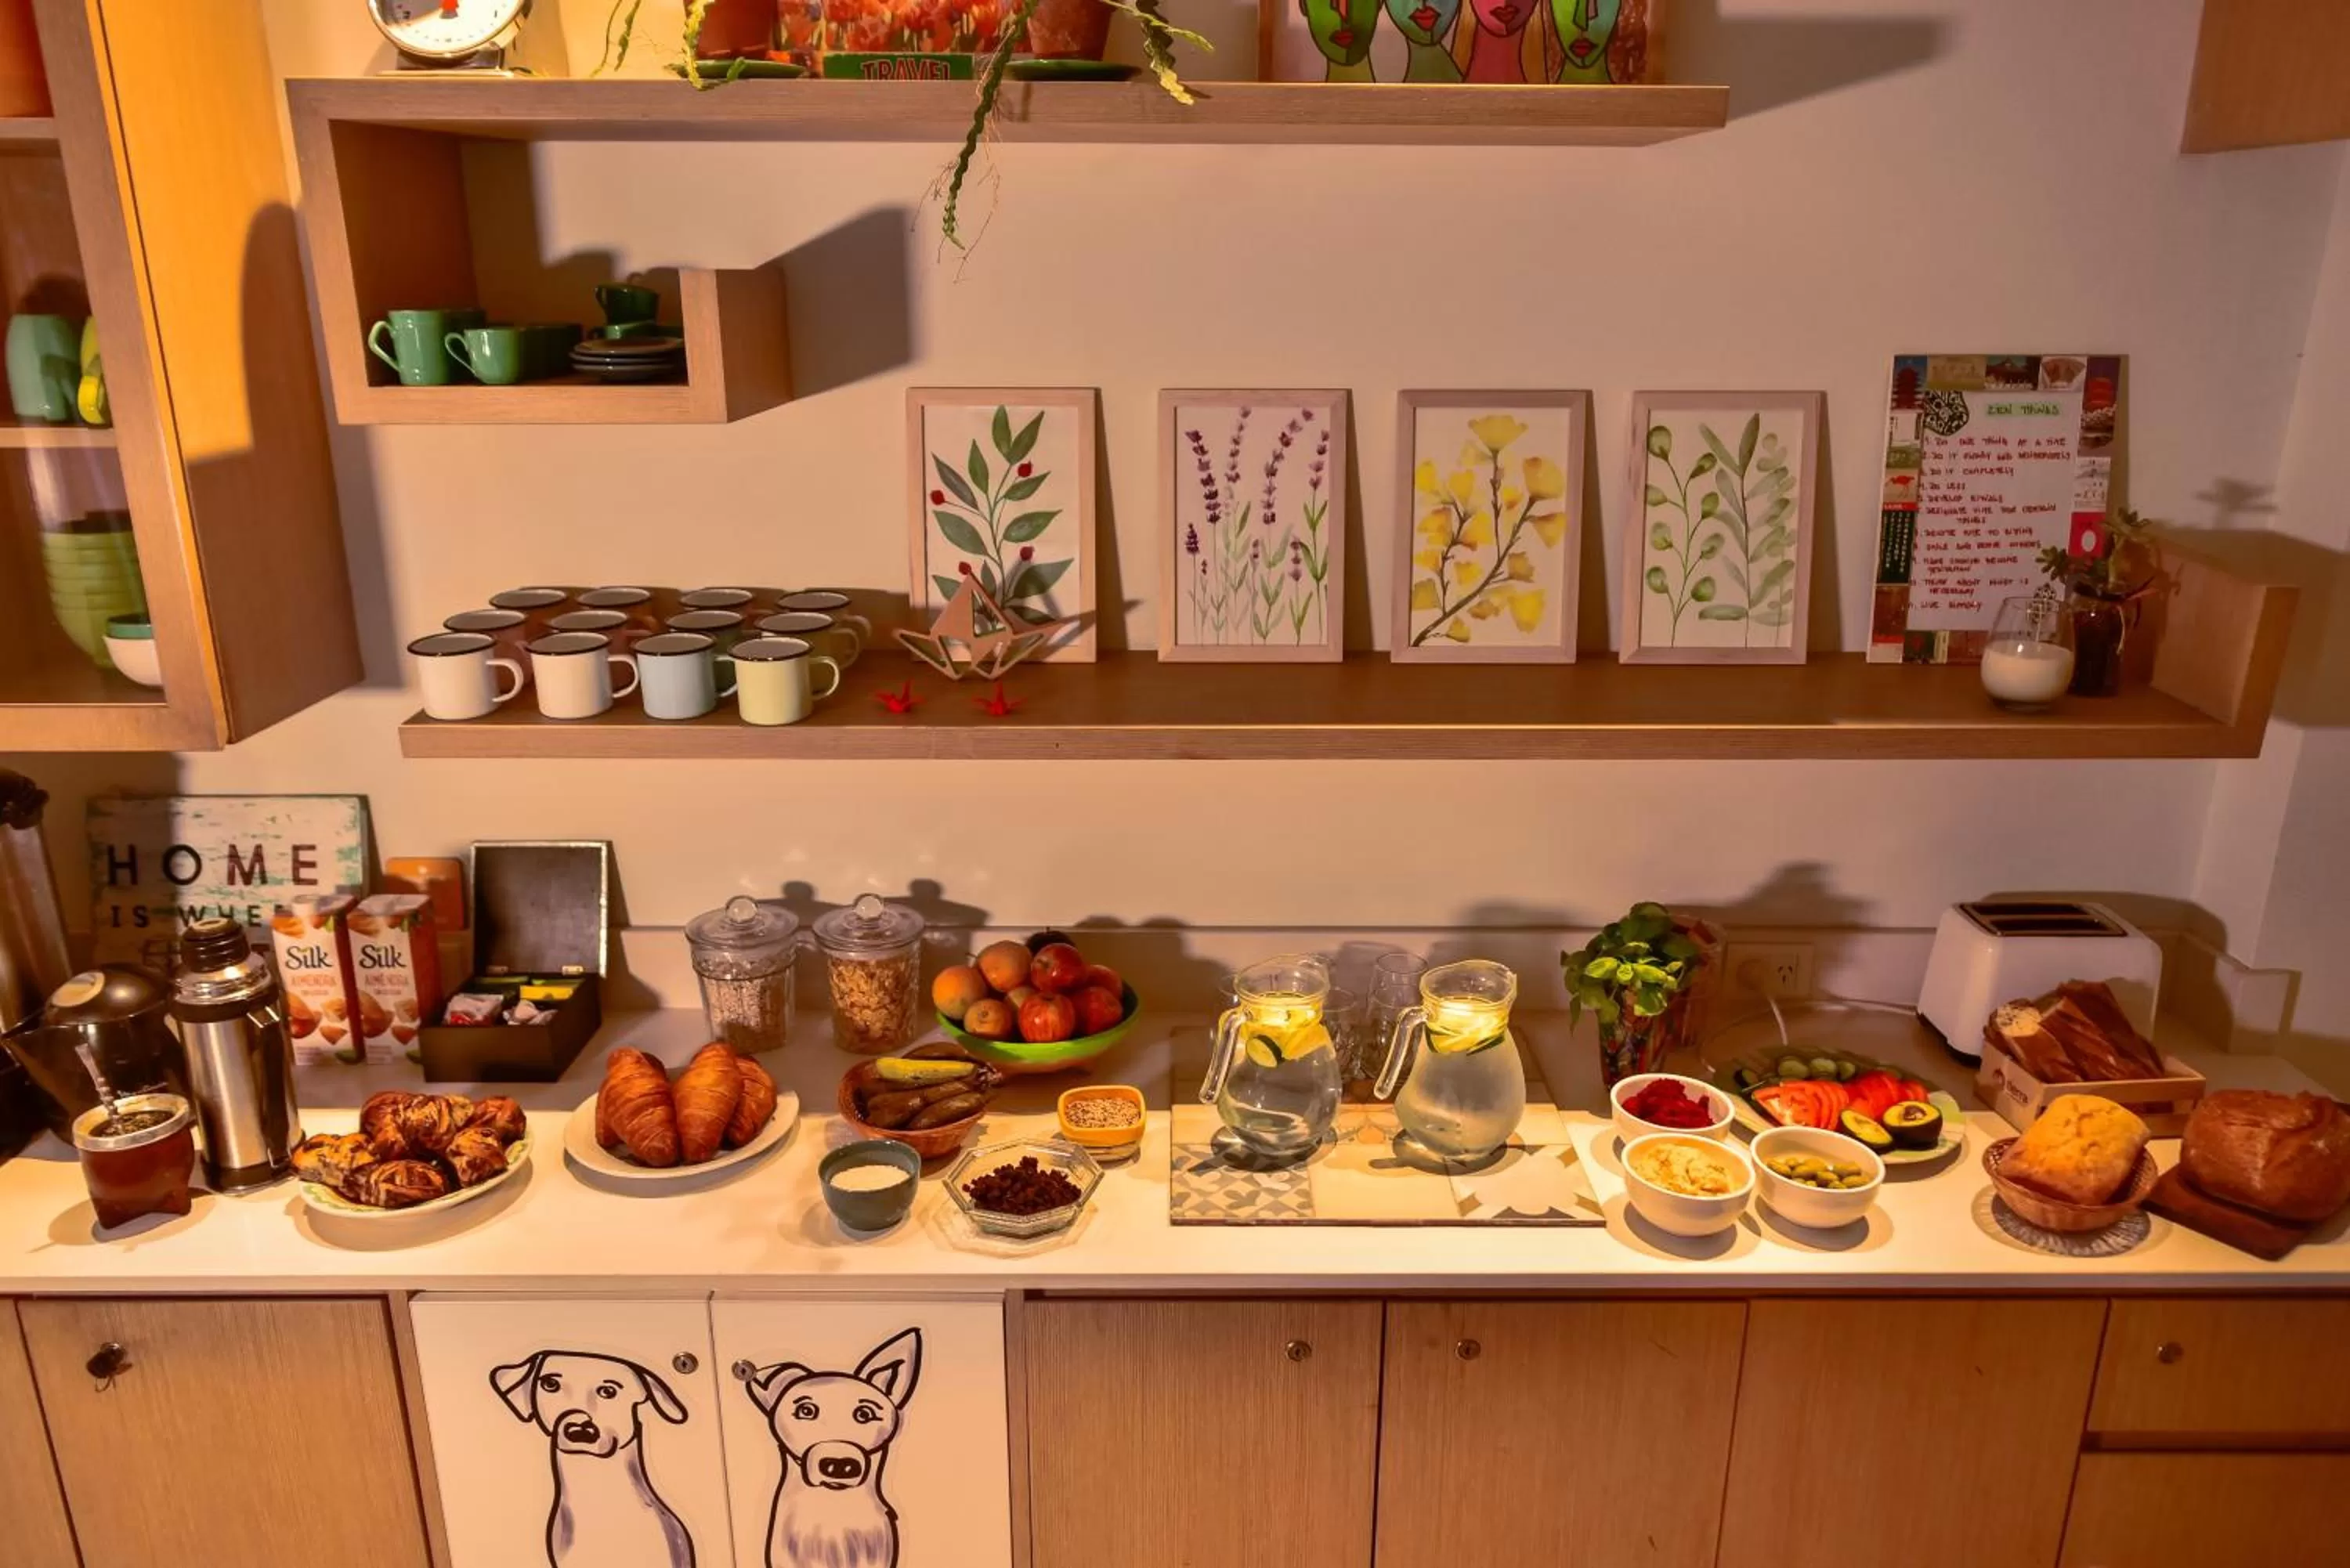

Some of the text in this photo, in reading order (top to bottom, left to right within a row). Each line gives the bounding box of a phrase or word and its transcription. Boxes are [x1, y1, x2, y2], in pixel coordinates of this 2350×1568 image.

[107, 844, 318, 886] HOME
[110, 905, 150, 928] IS
[284, 944, 334, 970] Silk
[359, 943, 408, 970] Silk
